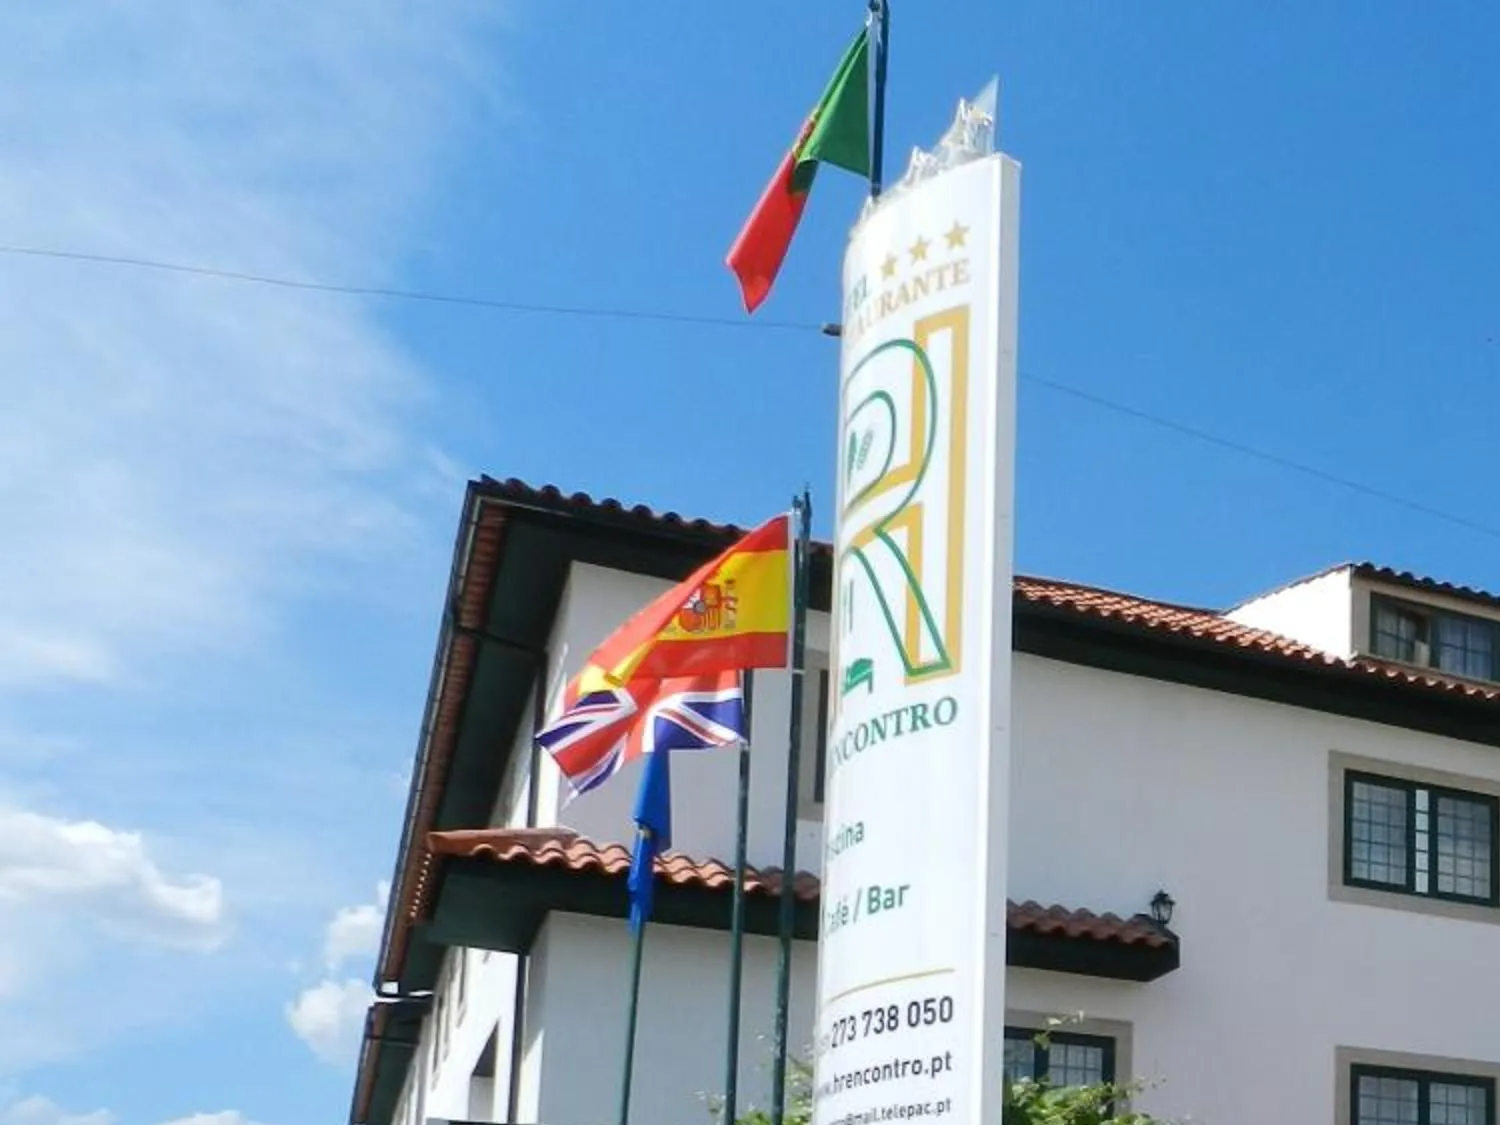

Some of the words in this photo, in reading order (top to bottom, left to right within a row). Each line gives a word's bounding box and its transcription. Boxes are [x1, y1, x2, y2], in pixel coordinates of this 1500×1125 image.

[867, 884, 910, 915] Bar
[831, 1015, 857, 1048] 273
[862, 1004, 899, 1037] 738
[907, 996, 953, 1028] 050
